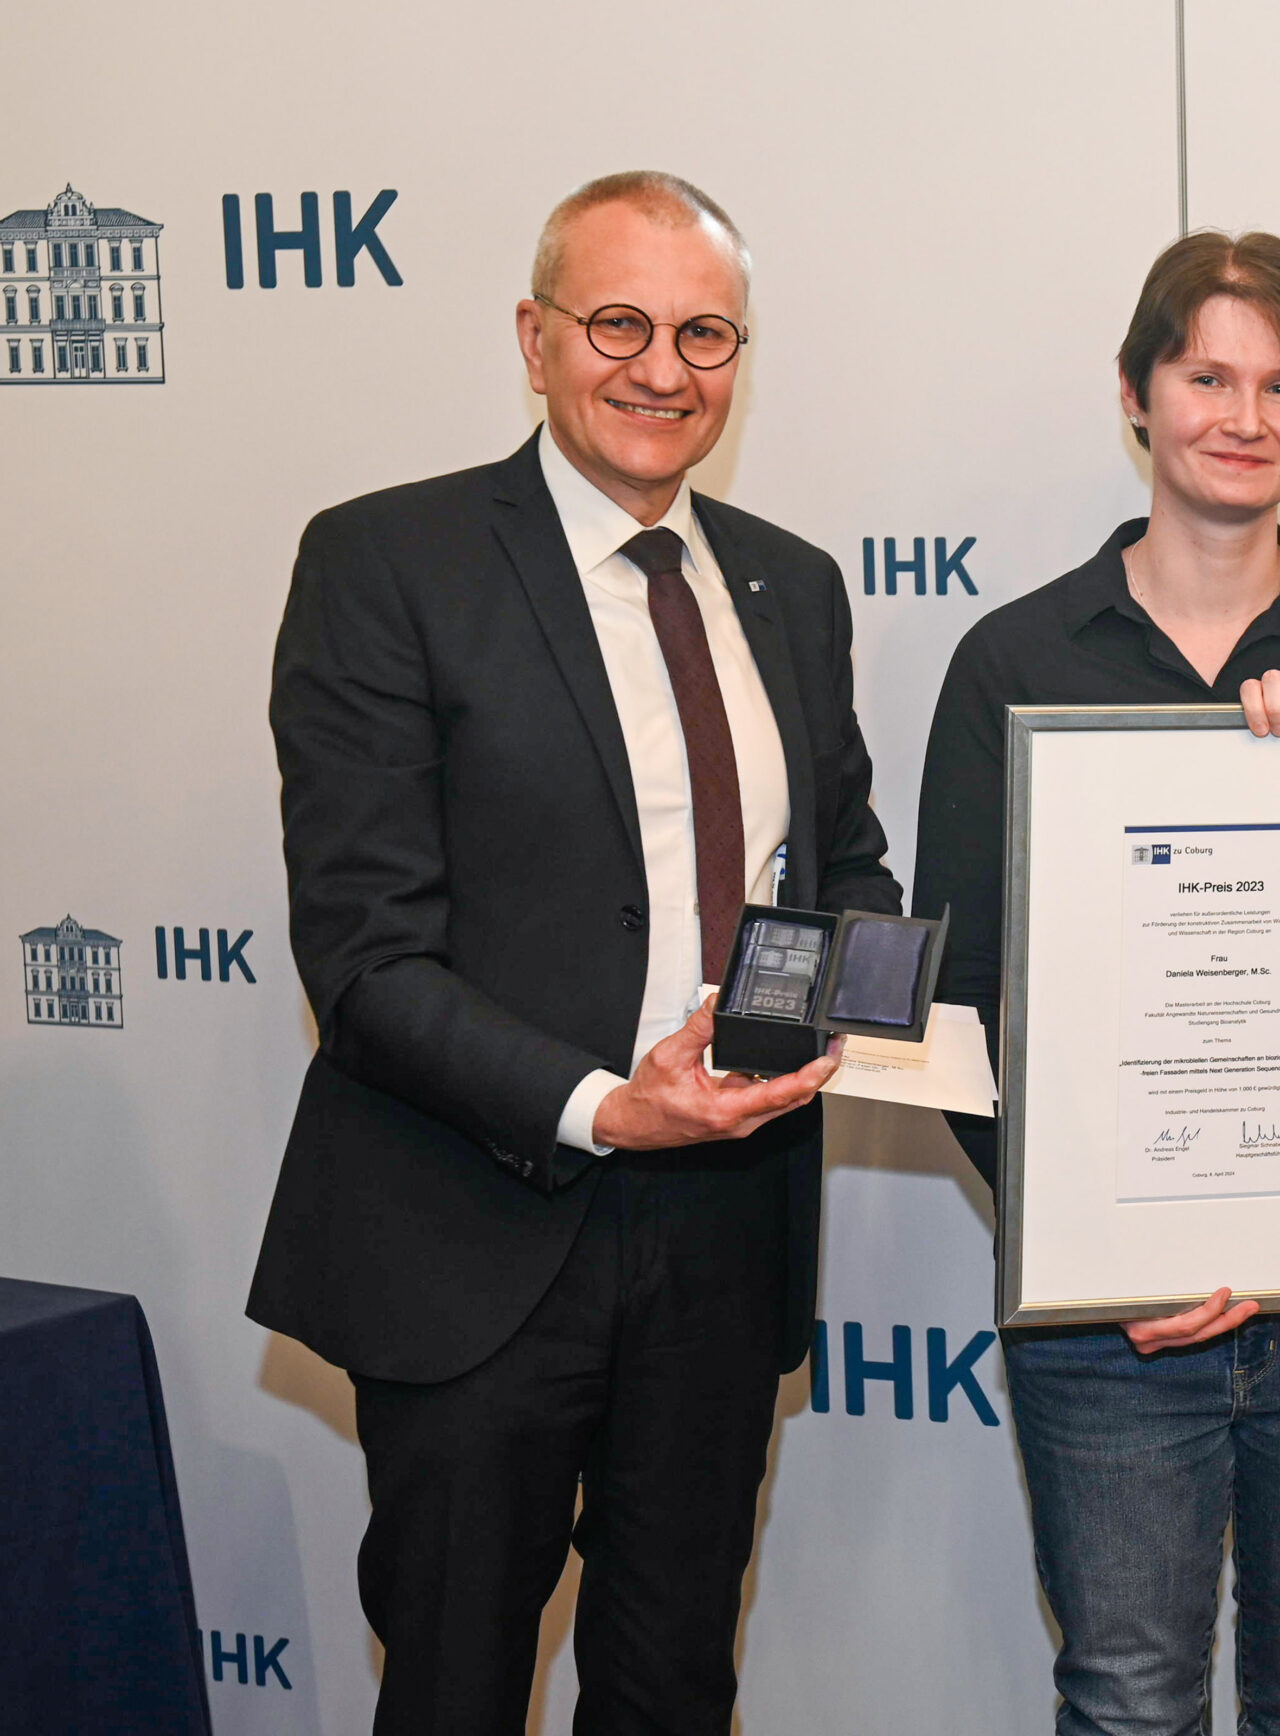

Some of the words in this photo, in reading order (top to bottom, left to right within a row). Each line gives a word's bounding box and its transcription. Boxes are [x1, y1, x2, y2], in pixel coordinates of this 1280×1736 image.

[222, 188, 404, 290] IHK
[862, 536, 979, 596] IHK
[1153, 846, 1170, 855] IHK
[1184, 846, 1213, 856] Coburg
[1178, 881, 1233, 893] IHK-Preis
[1235, 880, 1265, 892] 2023
[155, 925, 257, 984] IHK
[1196, 969, 1249, 977] Weisenberger,
[751, 994, 796, 1010] 2023
[810, 1319, 1002, 1428] IHK
